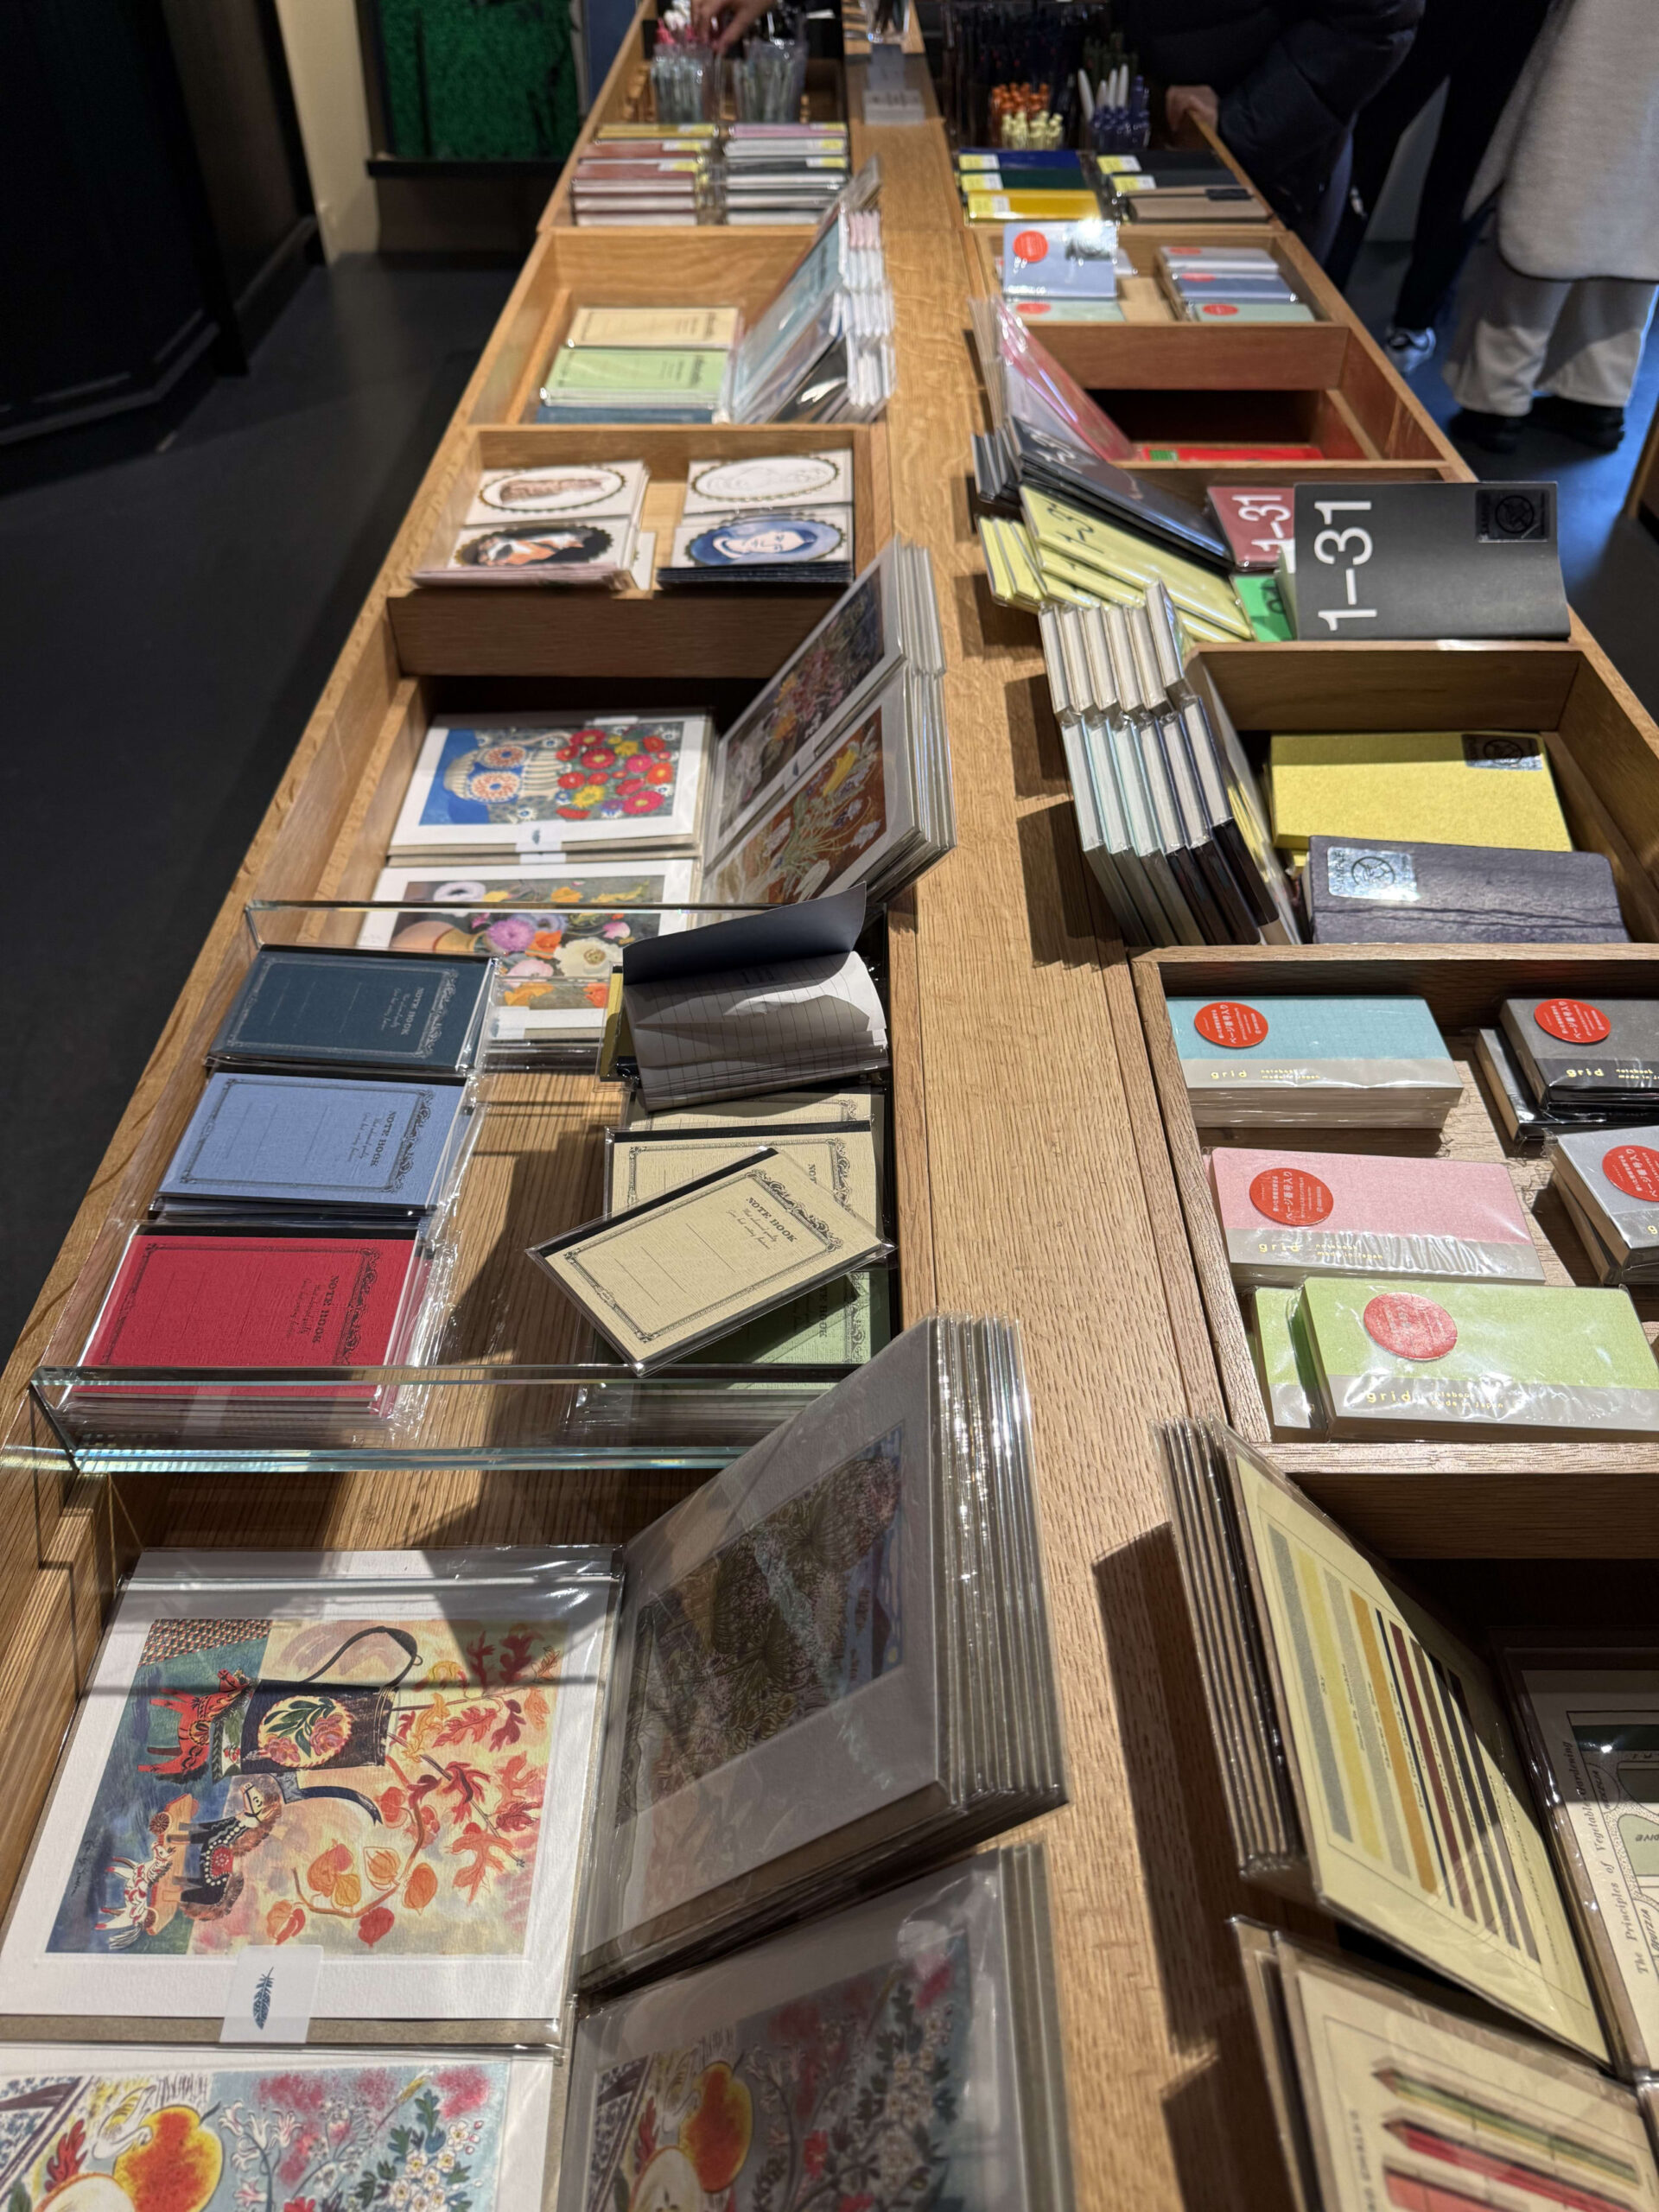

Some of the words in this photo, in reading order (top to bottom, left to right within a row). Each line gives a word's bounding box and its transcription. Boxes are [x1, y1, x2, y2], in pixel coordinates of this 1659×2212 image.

[1314, 500, 1377, 631] 1-31
[1211, 1070, 1247, 1079] grid
[1566, 1068, 1605, 1077] grid
[382, 1111, 397, 1136] NOTE
[371, 1138, 386, 1167] BOOK
[807, 1163, 817, 1185] NOT
[1283, 1171, 1294, 1221] ページ番号入り
[745, 1197, 772, 1219] NOTE
[769, 1218, 798, 1242] BOOK
[1259, 1243, 1300, 1253] grid
[324, 1275, 339, 1306] NOTE
[312, 1310, 329, 1344] BOOK
[1367, 1390, 1410, 1402] grid
[1607, 1862, 1616, 1874] of
[1611, 1882, 1637, 1941] Principles
[1634, 1952, 1649, 1974] The
